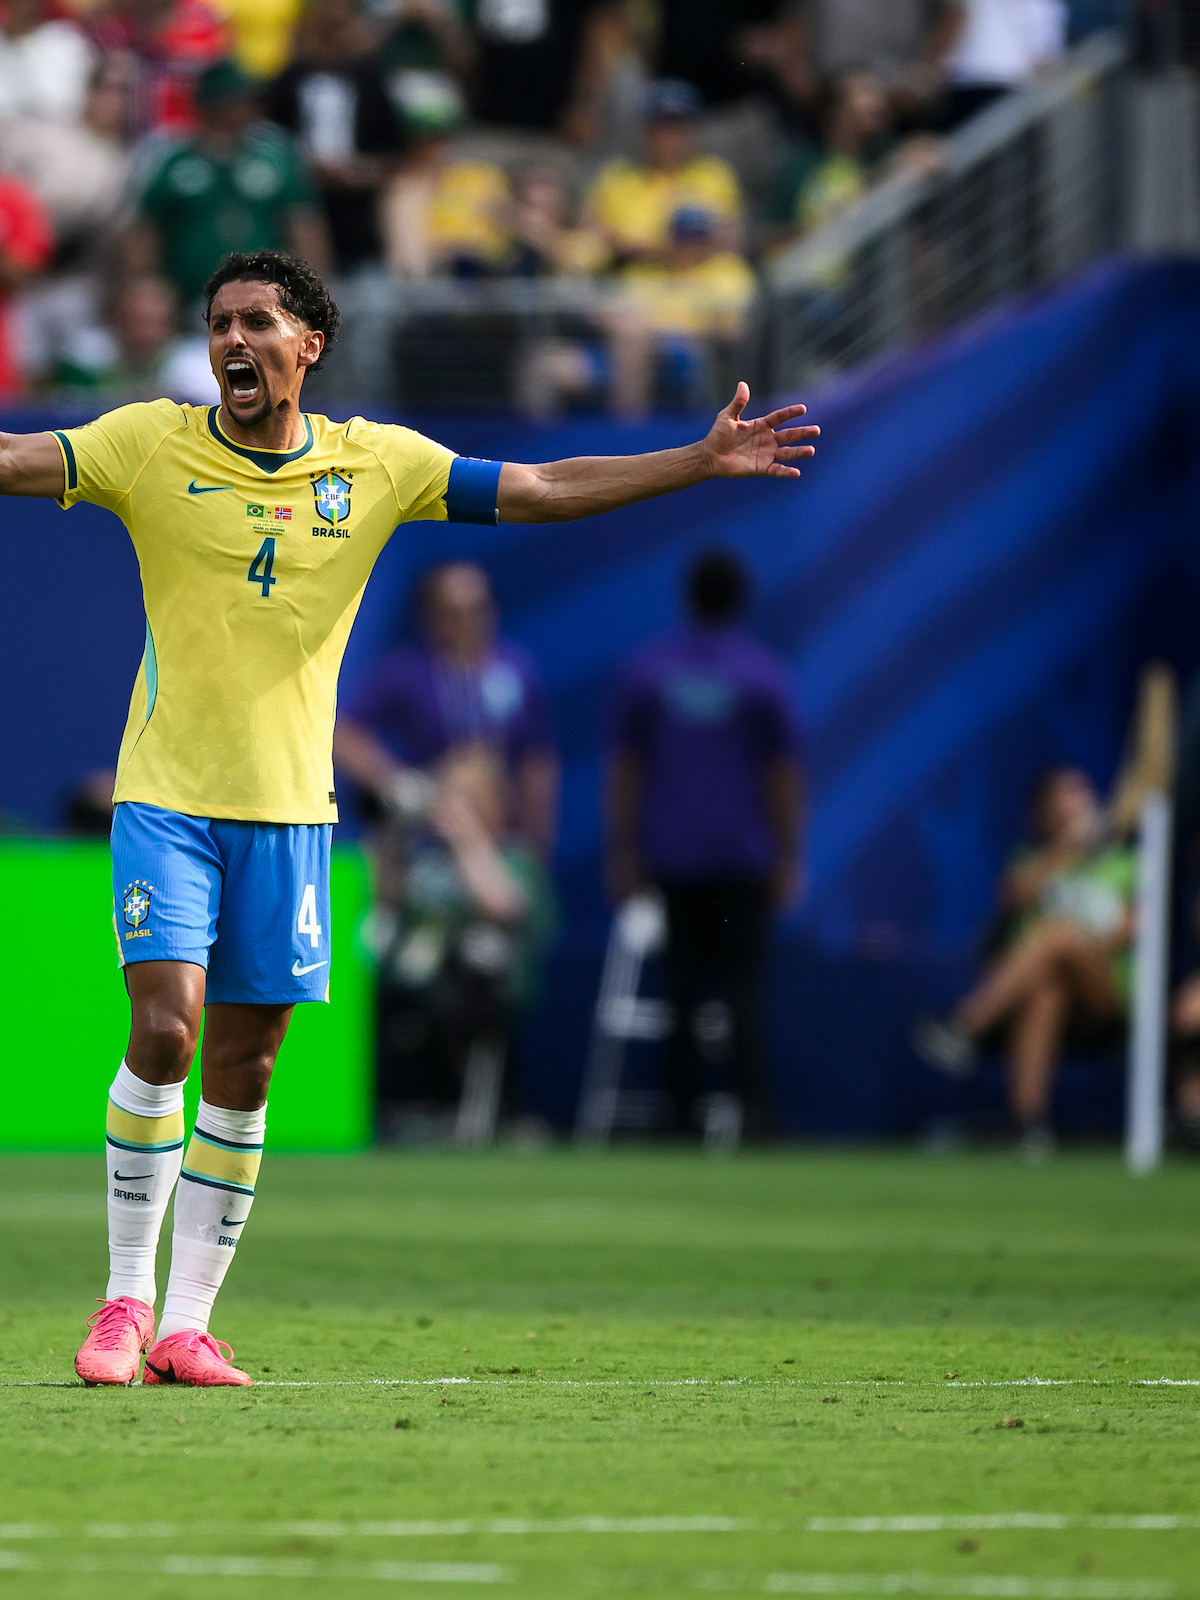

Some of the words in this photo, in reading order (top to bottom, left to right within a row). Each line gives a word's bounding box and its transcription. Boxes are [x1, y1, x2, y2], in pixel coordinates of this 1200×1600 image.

[325, 493, 341, 501] CBF
[311, 527, 351, 539] BRASIL
[247, 536, 277, 598] 4
[298, 884, 322, 948] 4
[125, 929, 153, 941] BRASIL
[113, 1188, 151, 1202] BRASIL
[218, 1235, 239, 1248] BRAS
